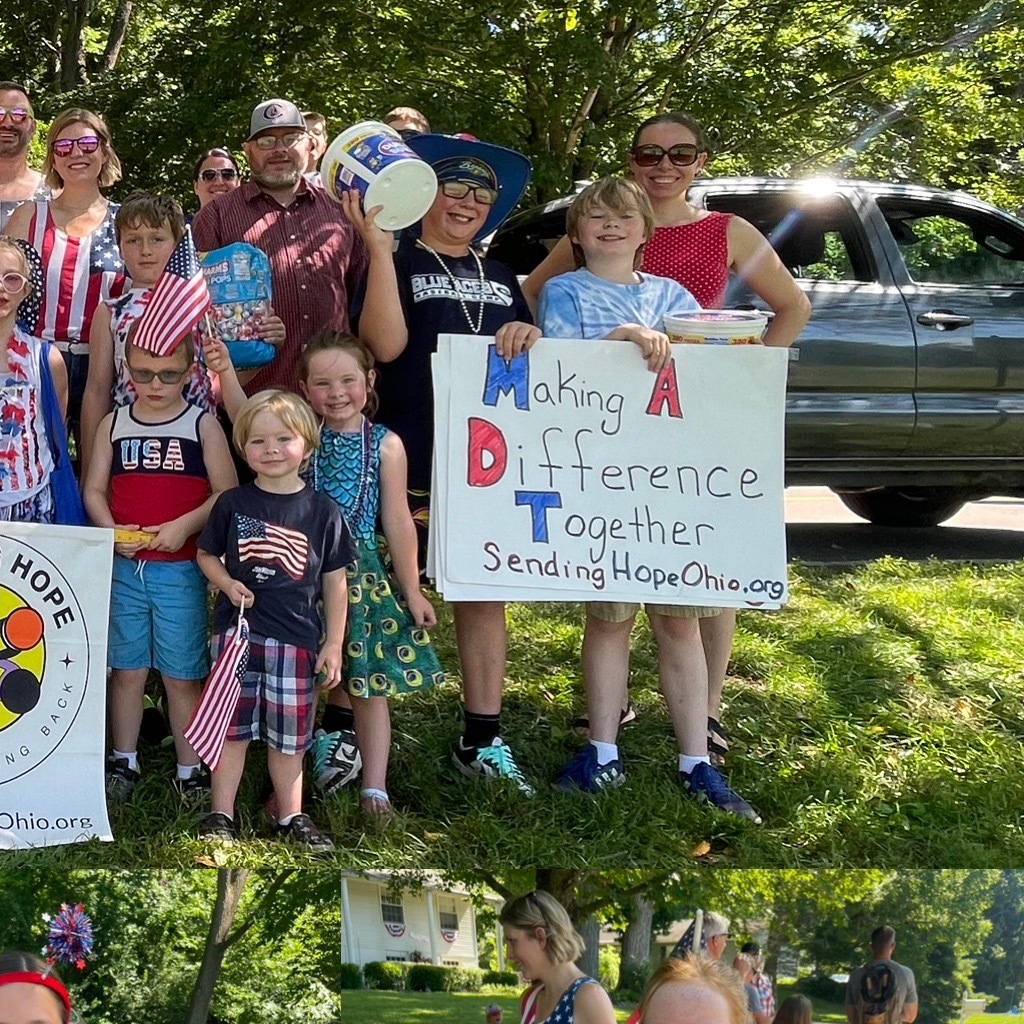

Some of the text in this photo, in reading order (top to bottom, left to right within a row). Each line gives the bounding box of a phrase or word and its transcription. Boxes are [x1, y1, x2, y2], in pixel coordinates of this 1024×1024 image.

[410, 275, 452, 291] BLUE
[482, 343, 684, 436] Making A
[121, 439, 184, 470] USA
[467, 416, 764, 500] Difference
[514, 490, 715, 564] Together
[10, 553, 75, 630] HOPE
[482, 541, 785, 600] SendingHopeOhio.org
[40, 682, 73, 737] BACK
